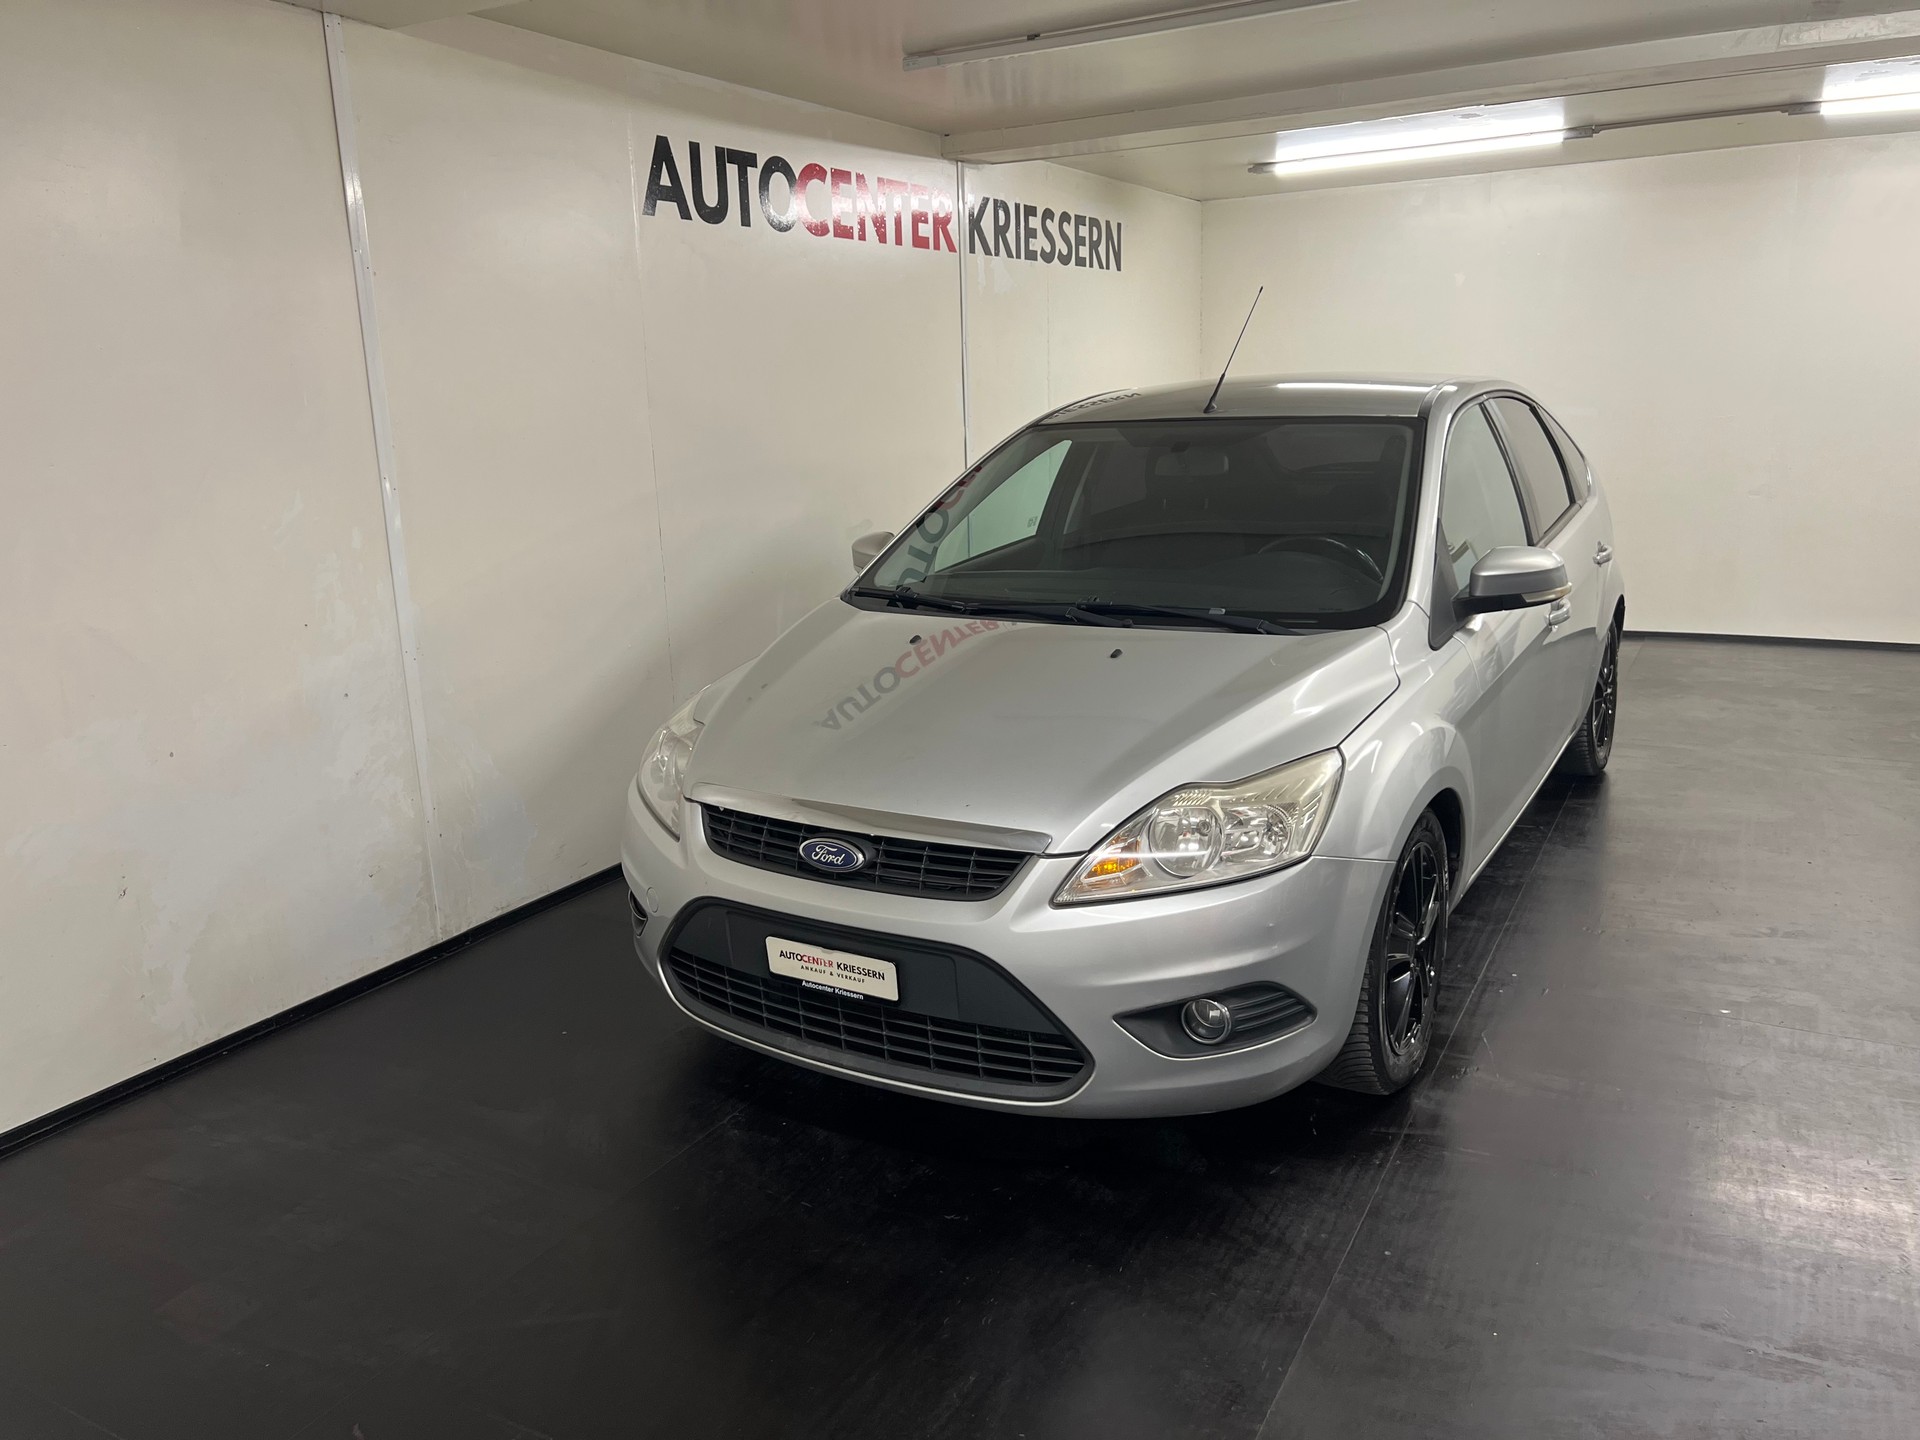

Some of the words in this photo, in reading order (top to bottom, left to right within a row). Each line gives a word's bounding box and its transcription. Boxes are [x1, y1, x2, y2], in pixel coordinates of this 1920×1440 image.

[642, 135, 957, 253] AUTOCENTER
[969, 196, 1122, 272] KRIESSERN
[811, 844, 846, 865] Ford
[779, 949, 834, 968] AUTOCENTER
[836, 961, 885, 981] KRIESSERN
[800, 965, 827, 975] ANKAUF
[836, 973, 865, 984] VERKAUF
[801, 980, 834, 993] Autocenter
[834, 987, 864, 1000] Kriessern
